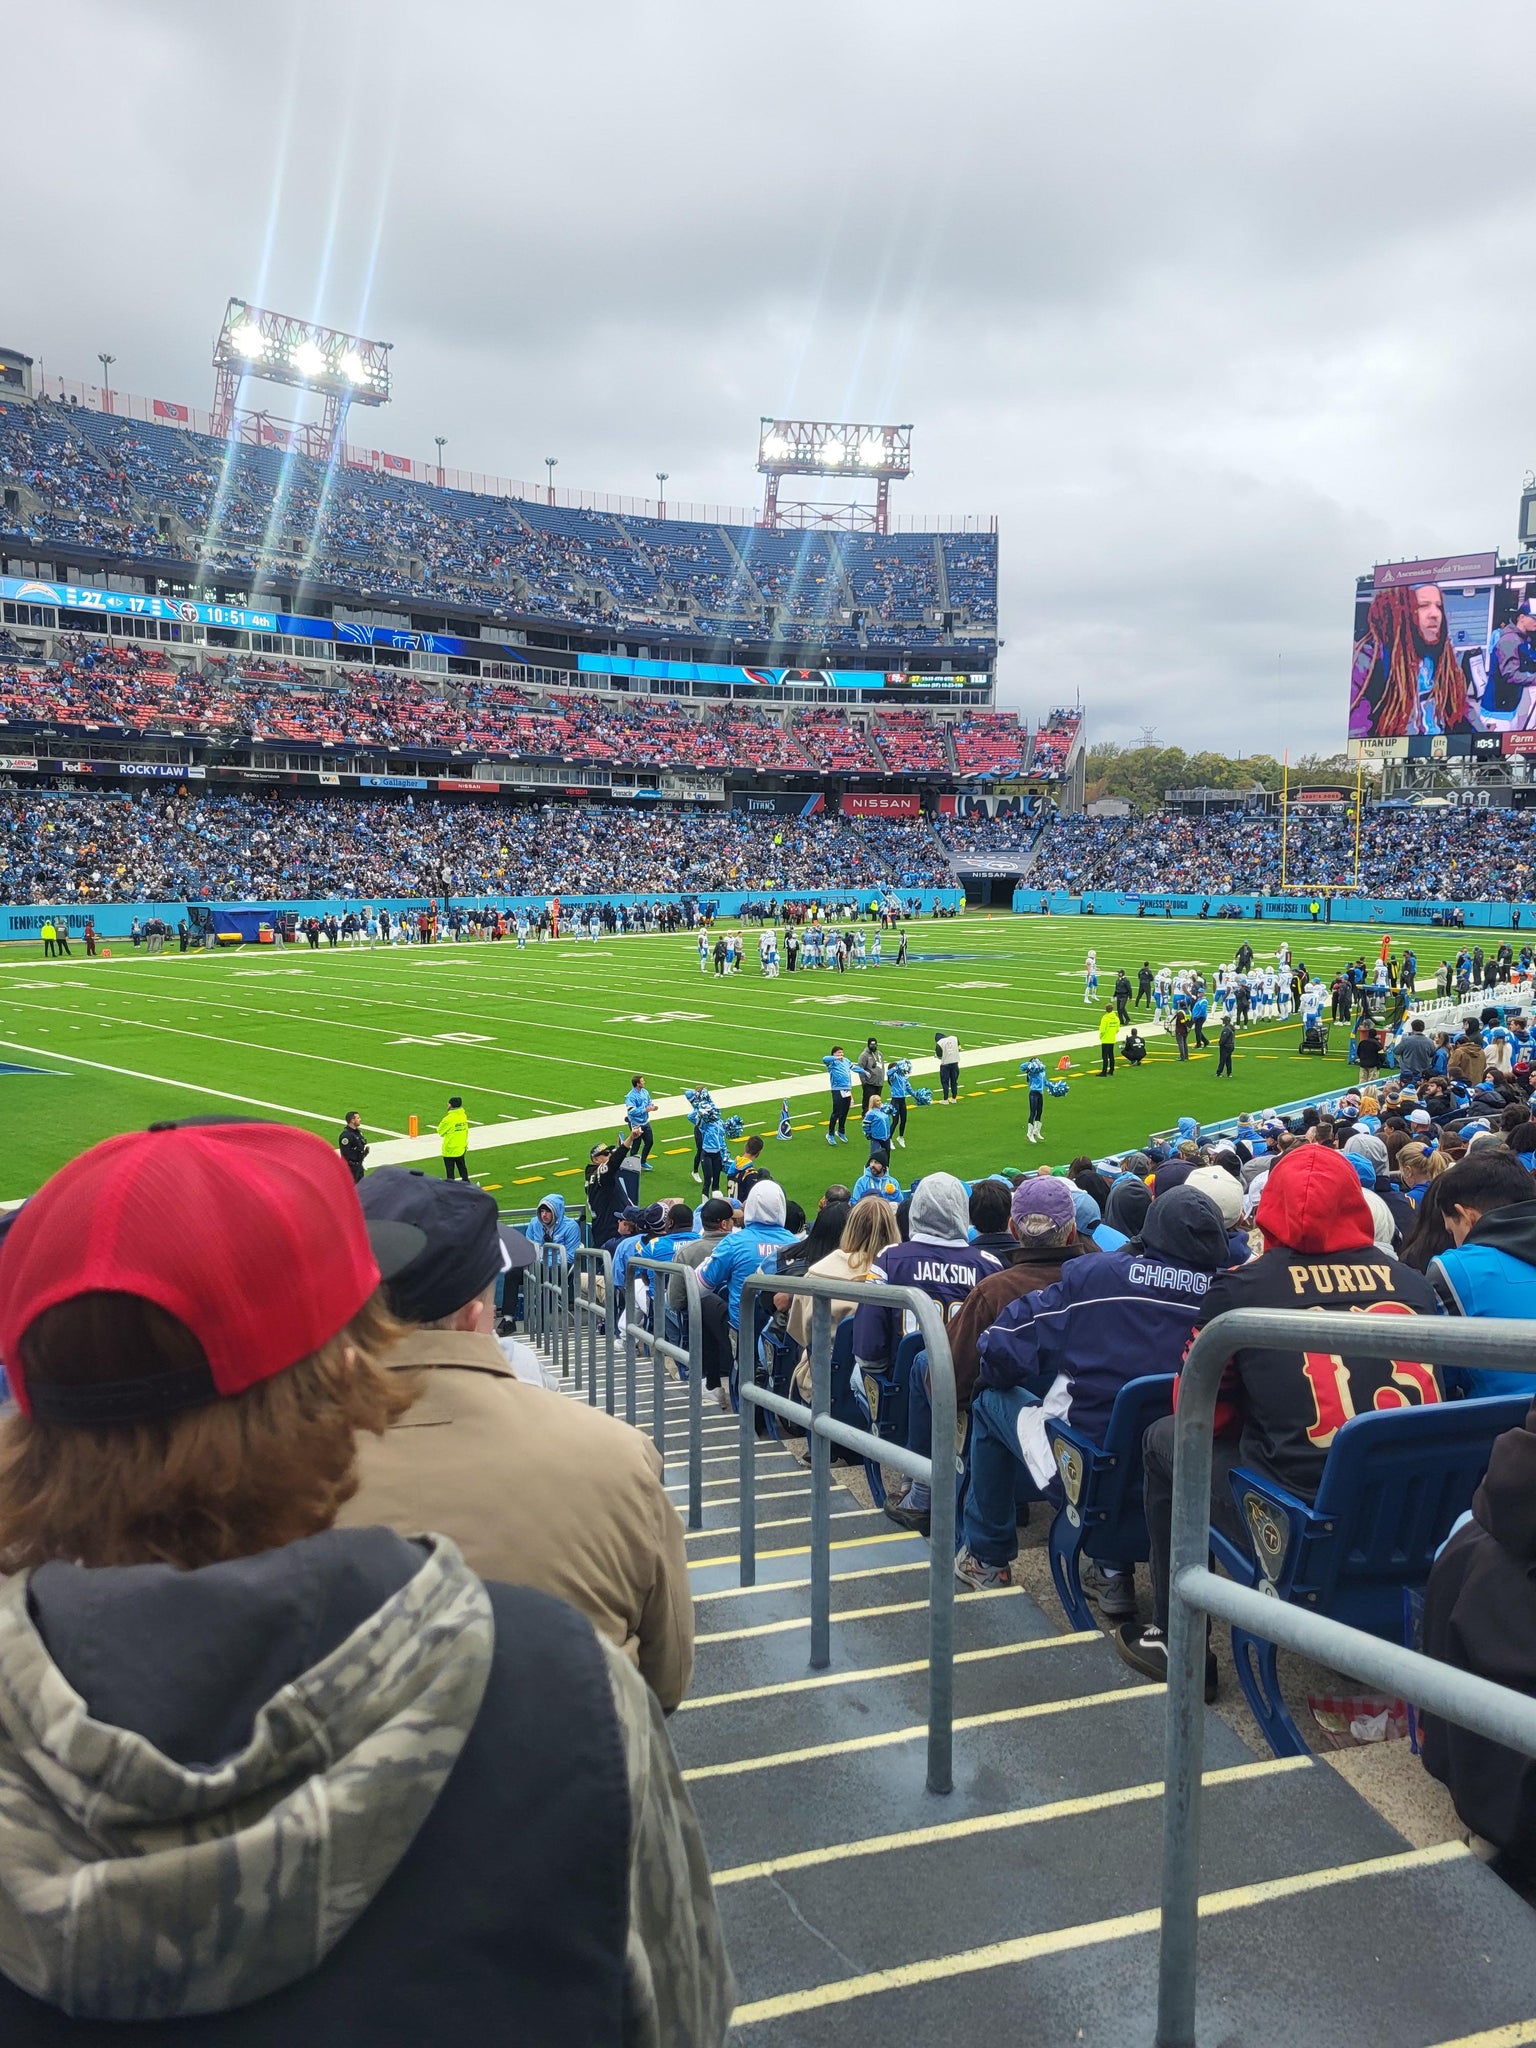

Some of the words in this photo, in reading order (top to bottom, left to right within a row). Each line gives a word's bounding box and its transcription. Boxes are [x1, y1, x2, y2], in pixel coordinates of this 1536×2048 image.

[81, 591, 102, 606] 27
[129, 597, 145, 612] 17
[207, 607, 245, 626] 10:51
[252, 615, 270, 628] 4th
[1360, 739, 1384, 748] TITAN
[1385, 738, 1398, 747] UP
[1510, 735, 1534, 743] Farm
[119, 764, 158, 775] ROCKY
[160, 766, 184, 776] LAW
[383, 778, 418, 787] Gallagher
[747, 798, 776, 811] TITANS
[852, 799, 911, 808] NISSAN
[1266, 902, 1298, 914] TENNESSEE
[602, 1010, 716, 1024] 20
[913, 1261, 977, 1287] JACKSON
[1288, 1264, 1396, 1294] PURDY
